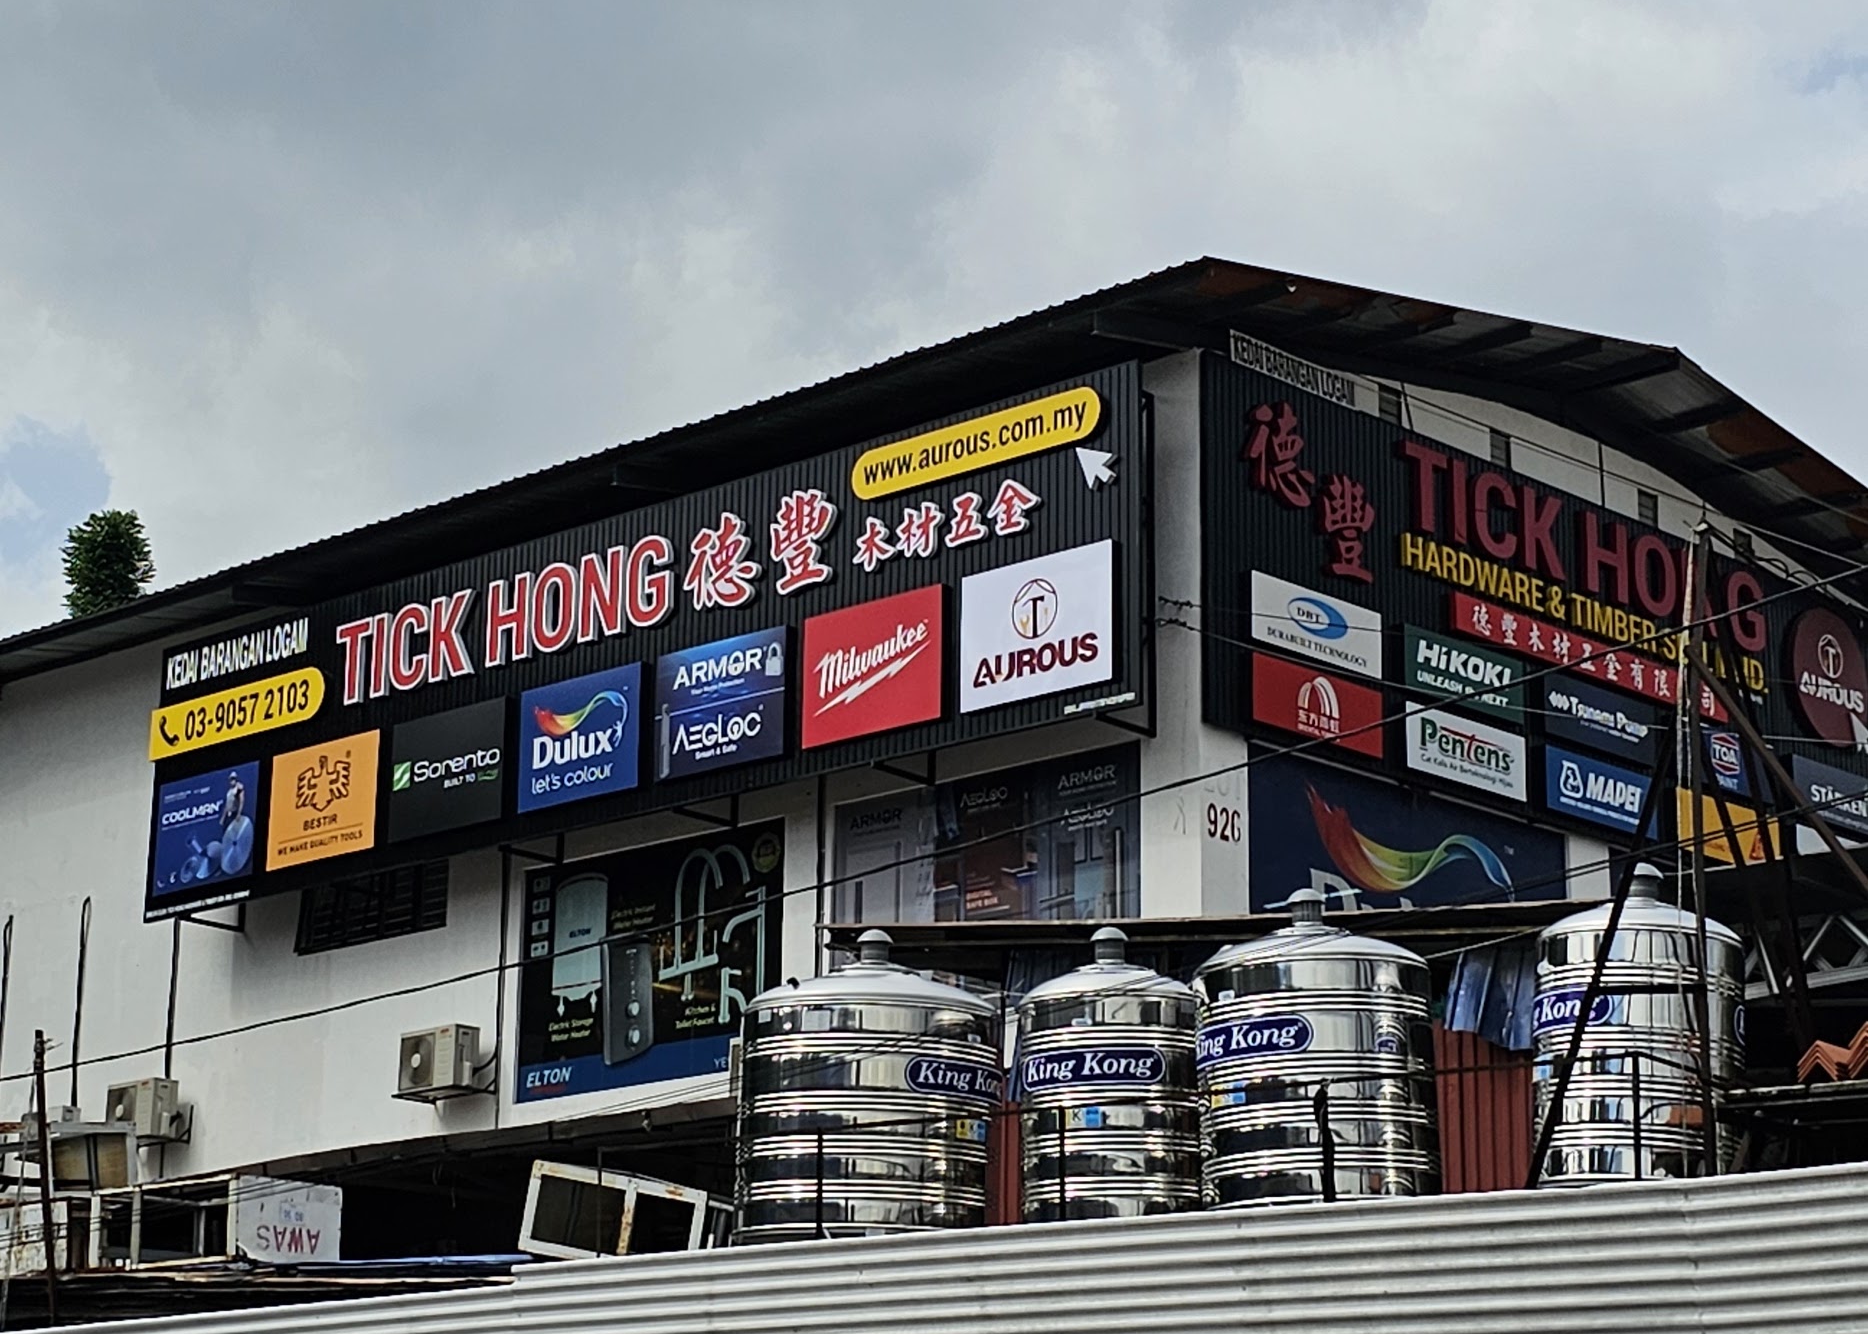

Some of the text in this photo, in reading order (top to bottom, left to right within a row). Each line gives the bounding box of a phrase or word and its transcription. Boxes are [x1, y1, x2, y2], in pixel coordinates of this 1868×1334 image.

[863, 400, 1087, 486] www.aurous.com.my
[1405, 441, 1565, 581] TICK
[683, 479, 1042, 610] 德豐 木材五金
[1404, 533, 1545, 613] HARDWARE
[1546, 585, 1565, 619] &
[1571, 593, 1657, 650] TIMBER
[336, 535, 674, 705] TICK HONG
[166, 617, 308, 690] KEDAI BARANGAN LOGAM
[672, 648, 762, 690] ARMOR
[814, 622, 928, 698] Milwaukee
[973, 633, 1098, 689] AUROUS
[1473, 603, 1715, 716] 德豐木材五金有限司
[1417, 670, 1463, 693] UNLEASH
[1799, 671, 1864, 713] AUROUS
[185, 679, 309, 741] 03-9057 2103
[413, 748, 500, 782] Sorento
[531, 729, 614, 770] Dulux
[1420, 717, 1512, 771] Pentens
[1713, 744, 1738, 764] TOA
[531, 761, 614, 795] let's colour
[1586, 773, 1642, 813] MAPEI
[1196, 1025, 1298, 1061] ing Kong
[526, 1066, 572, 1088] ELTON
[916, 1061, 972, 1091] King
[1027, 1052, 1154, 1083] King Kong
